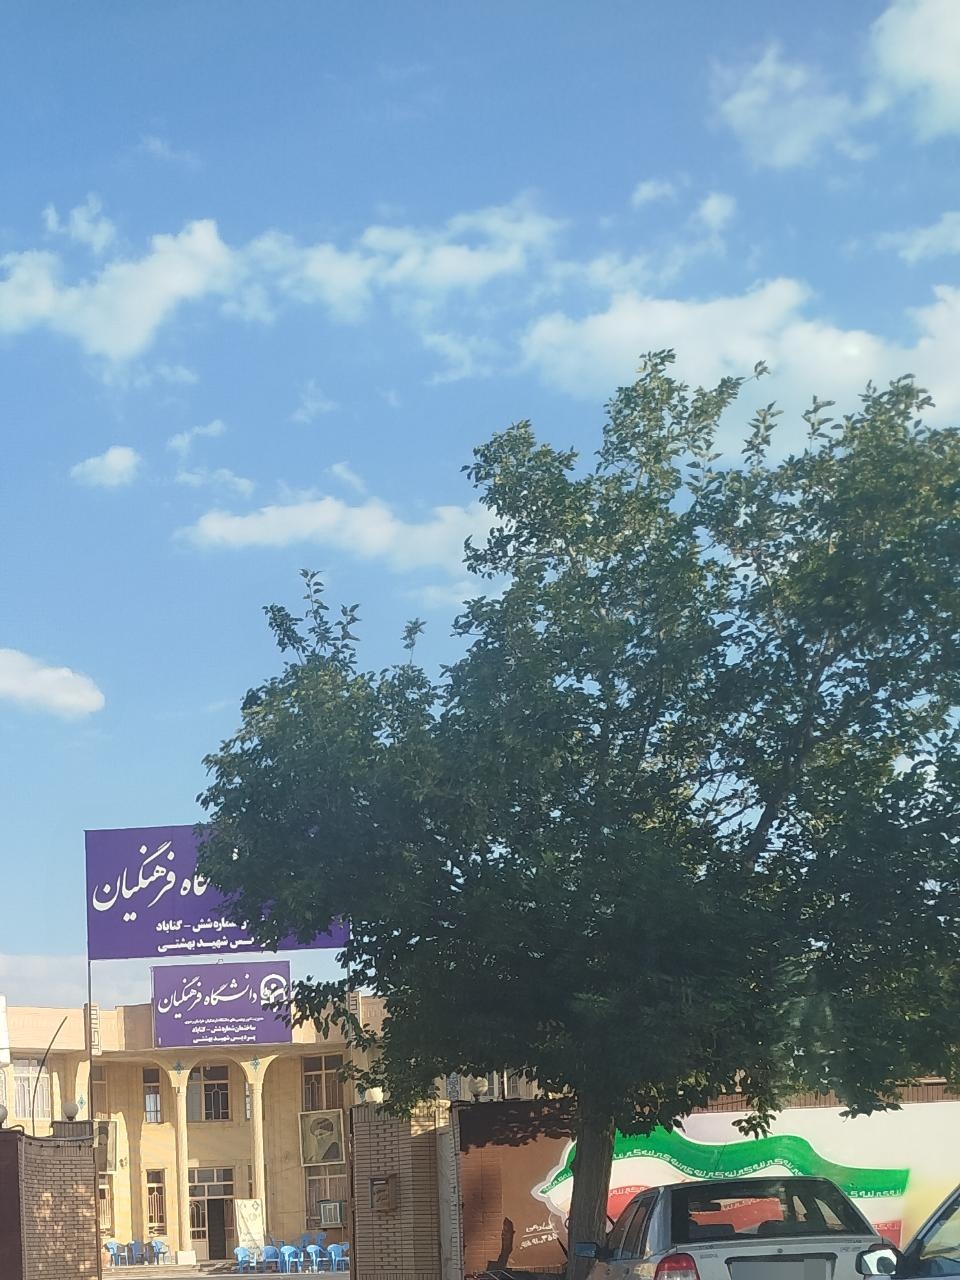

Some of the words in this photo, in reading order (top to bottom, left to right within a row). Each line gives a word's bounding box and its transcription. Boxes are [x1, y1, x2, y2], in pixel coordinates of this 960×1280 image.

[92, 840, 177, 922] فرهنگیان
[155, 919, 183, 934] گناباد
[192, 918, 213, 933] شش
[157, 937, 196, 953] بهشتی
[196, 935, 229, 950] شهید
[157, 976, 203, 1019] فرهنگیان
[203, 973, 258, 1006] دانشگاه
